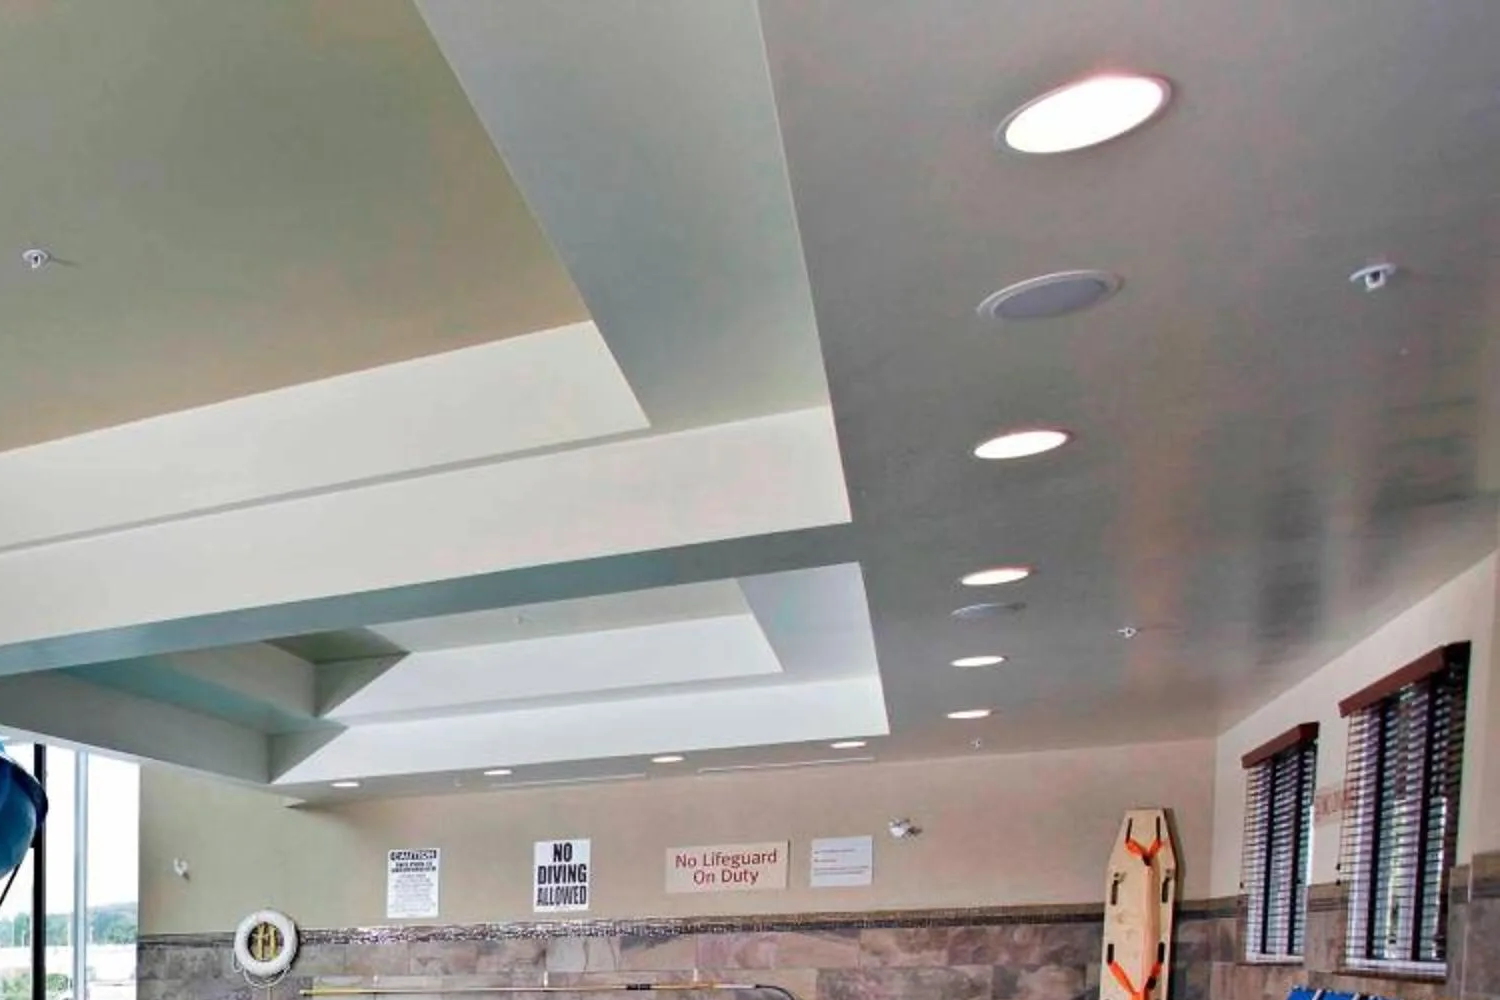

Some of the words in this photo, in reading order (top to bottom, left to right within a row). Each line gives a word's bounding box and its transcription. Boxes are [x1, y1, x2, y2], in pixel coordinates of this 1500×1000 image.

[552, 842, 573, 862] NO
[675, 854, 697, 869] No
[703, 848, 777, 869] Lifeguard
[537, 864, 587, 885] DIVING
[693, 869, 715, 885] On
[721, 869, 759, 885] Duty
[536, 886, 587, 906] ALLOWED
